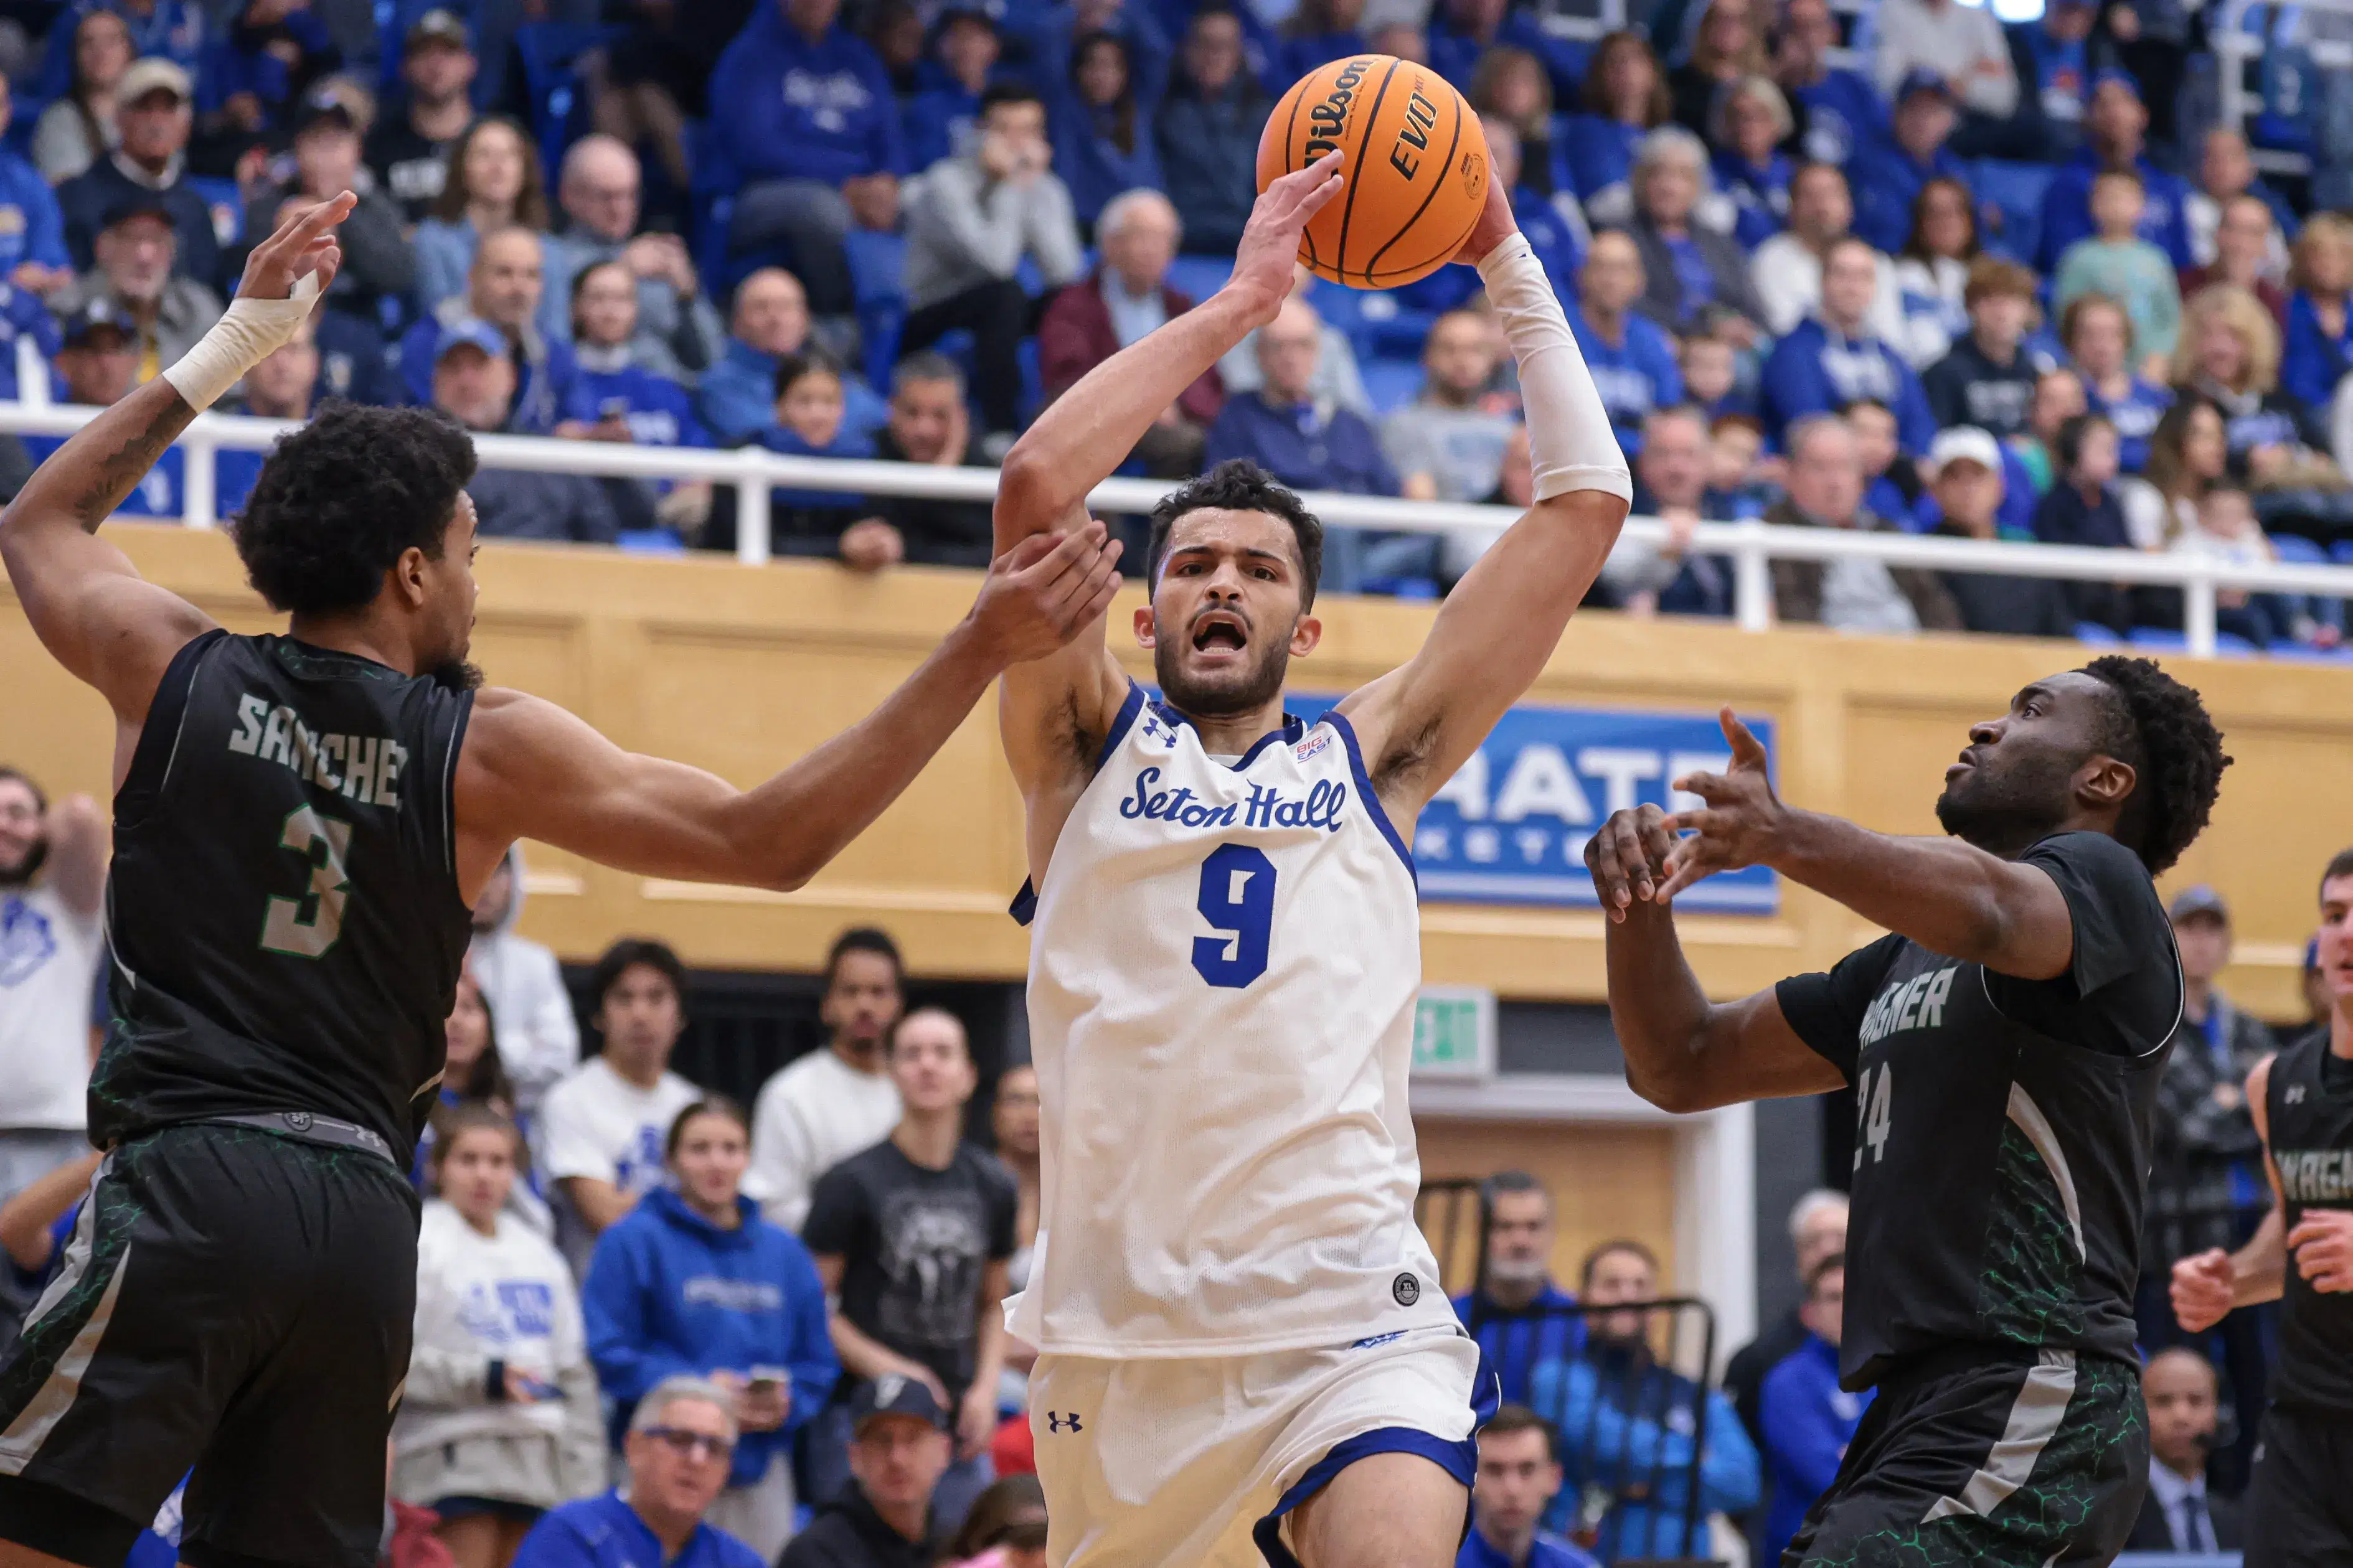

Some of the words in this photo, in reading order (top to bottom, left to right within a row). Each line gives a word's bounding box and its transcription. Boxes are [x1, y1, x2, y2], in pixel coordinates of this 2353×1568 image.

[1390, 91, 1438, 182] EVO
[229, 692, 408, 812] SANCHE
[1297, 736, 1322, 753] BIG
[1298, 735, 1332, 760] EAST
[1120, 767, 1238, 828] Seton
[1245, 778, 1346, 833] Hall
[259, 801, 353, 960] 3
[1191, 842, 1278, 989] 9
[1402, 1282, 1414, 1291] XL
